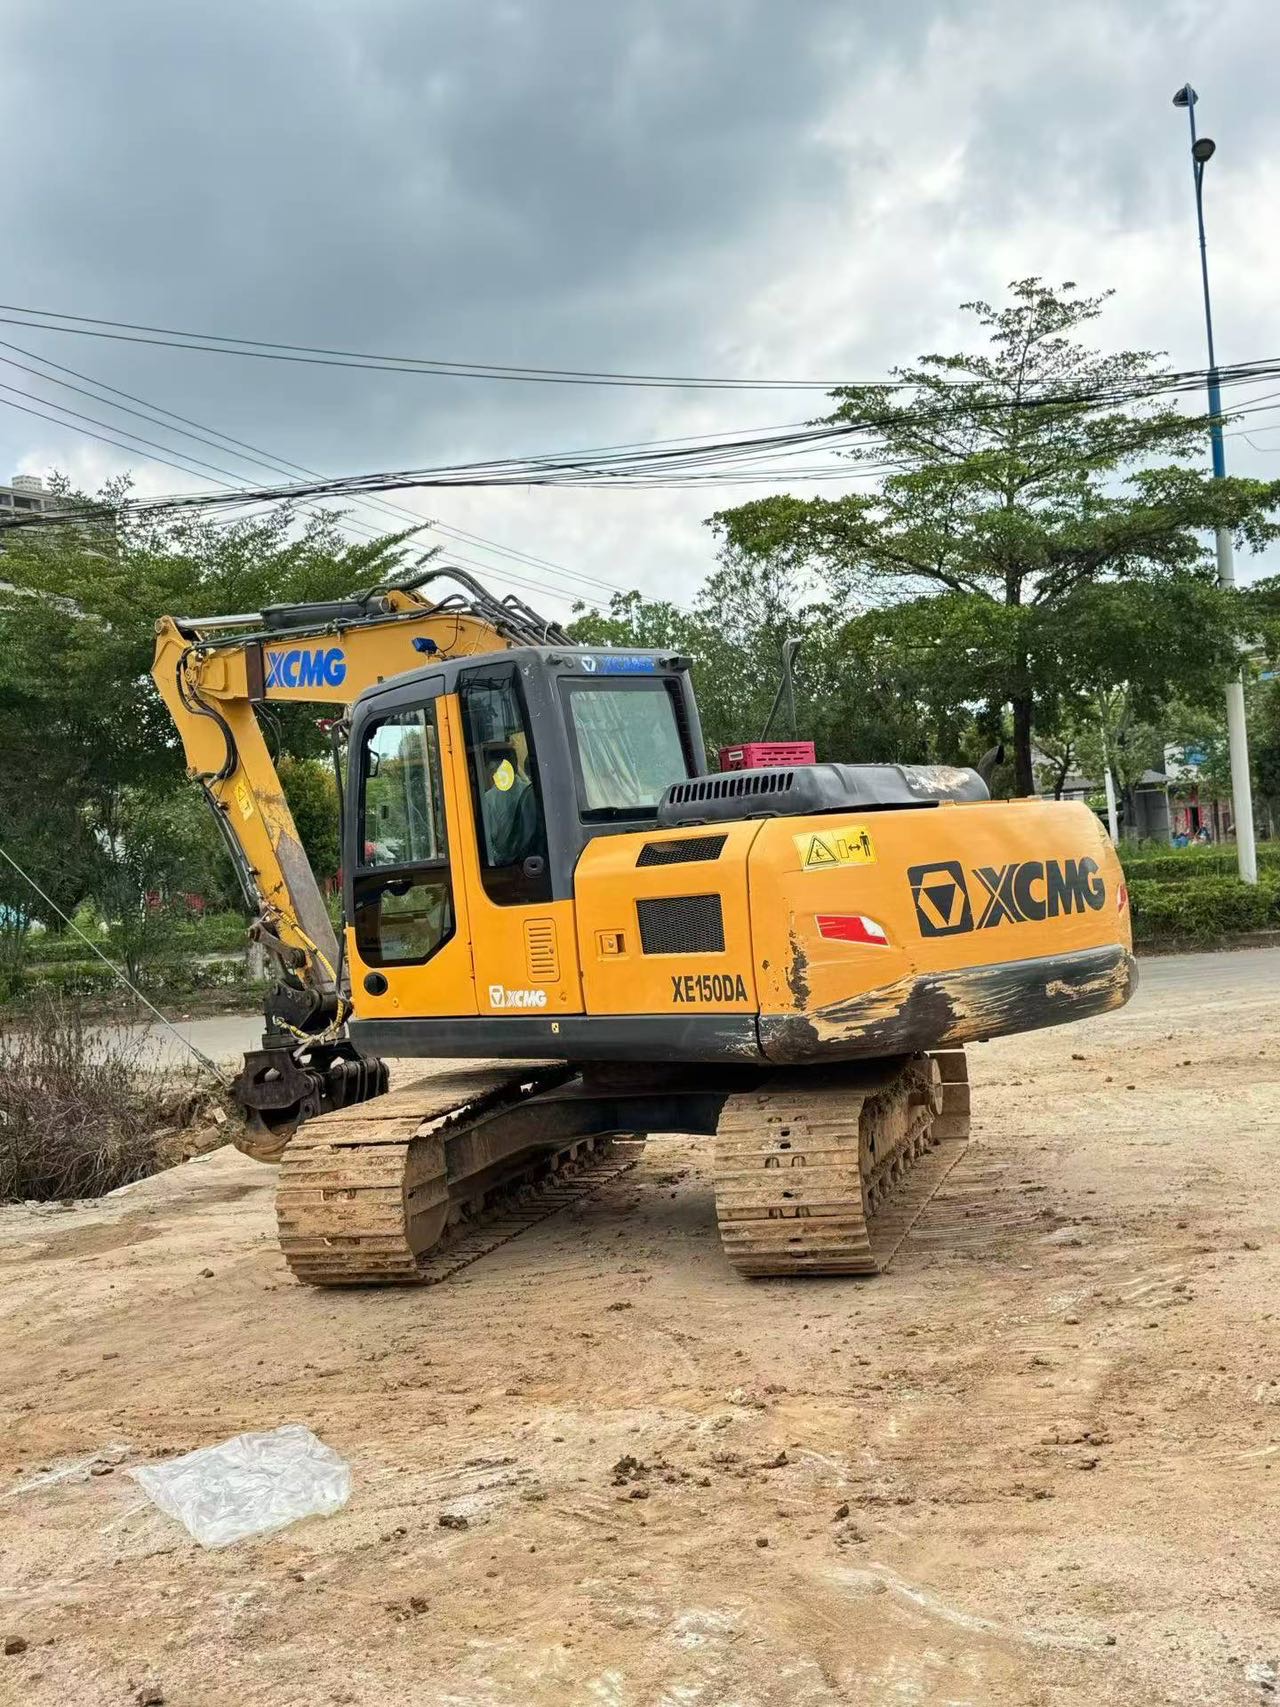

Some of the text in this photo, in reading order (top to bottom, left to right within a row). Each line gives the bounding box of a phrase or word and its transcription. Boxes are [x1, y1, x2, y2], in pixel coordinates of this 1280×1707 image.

[265, 648, 346, 688] XCMG
[972, 857, 1105, 930] XCMG
[505, 990, 547, 1008] XCMG
[672, 975, 748, 1003] XE150DA
